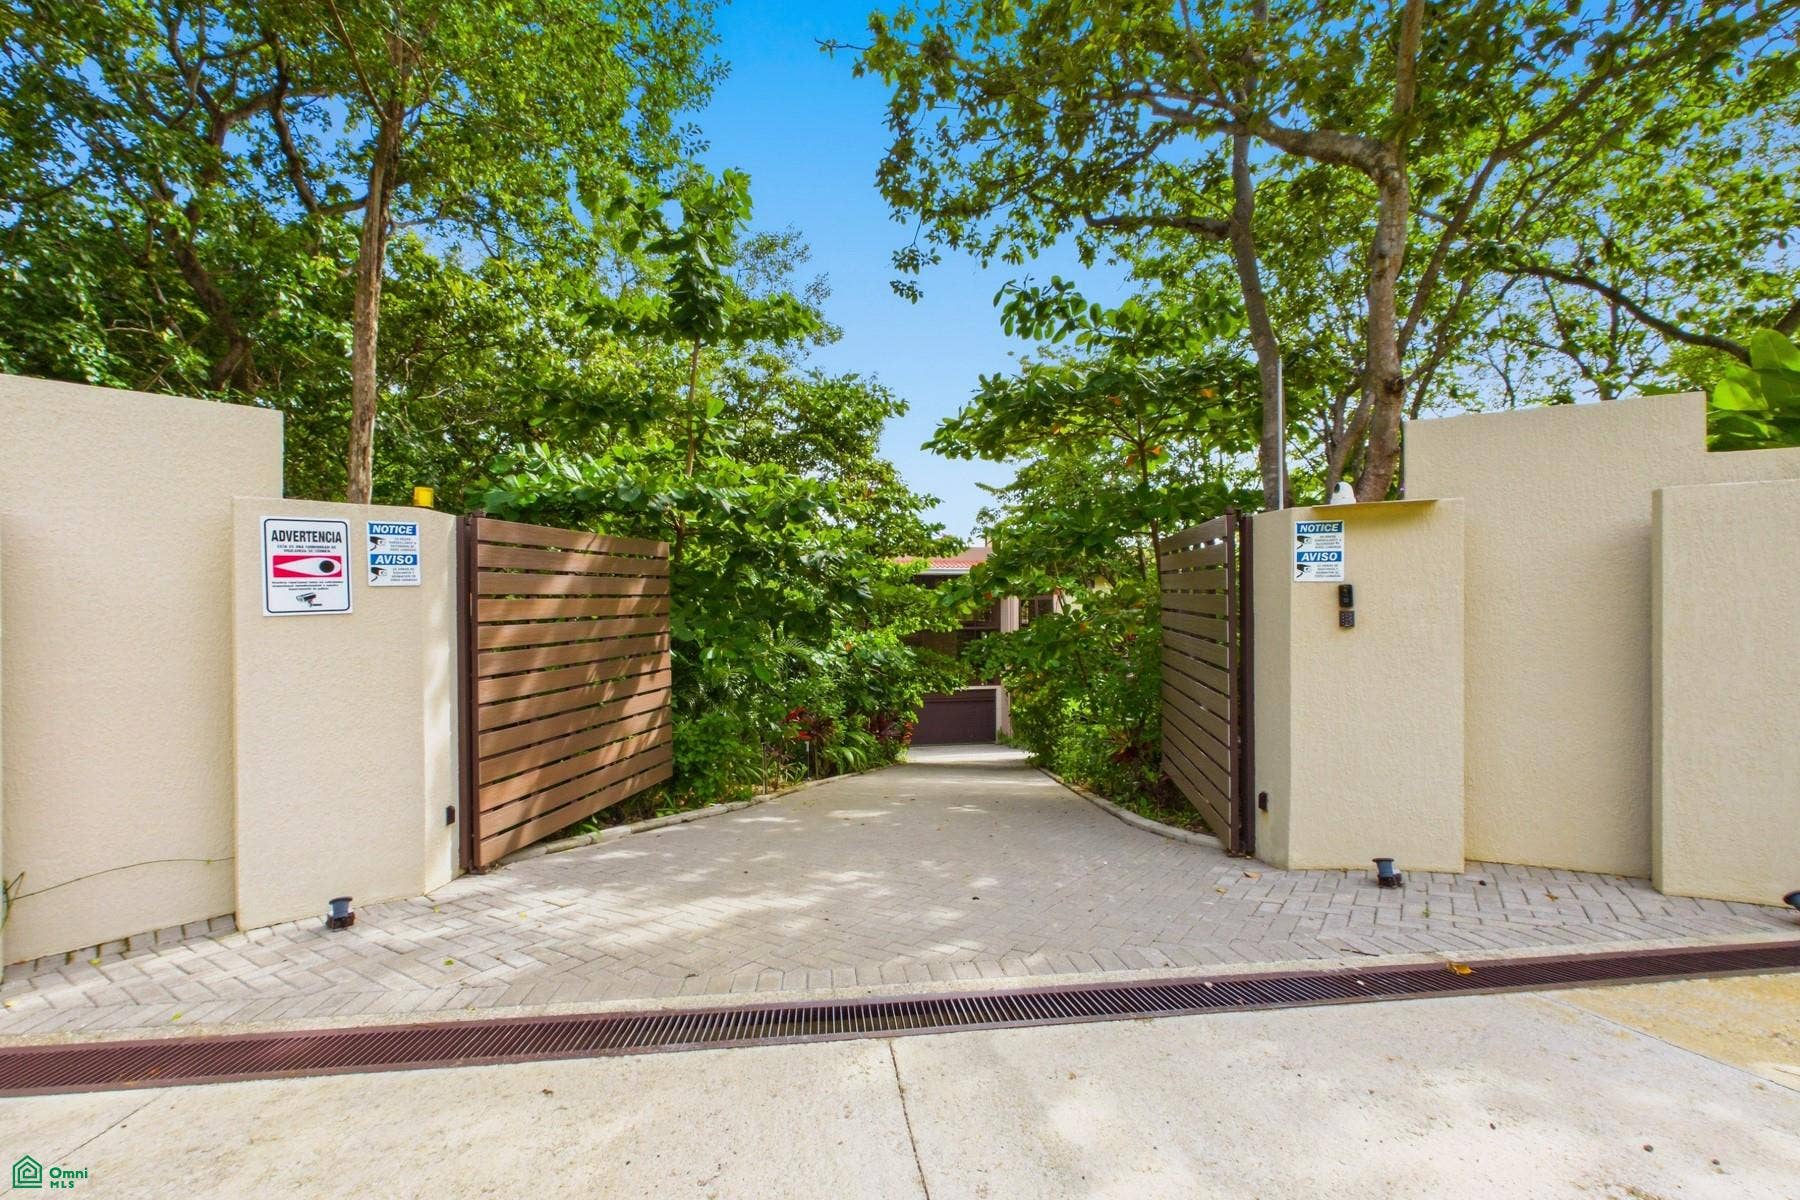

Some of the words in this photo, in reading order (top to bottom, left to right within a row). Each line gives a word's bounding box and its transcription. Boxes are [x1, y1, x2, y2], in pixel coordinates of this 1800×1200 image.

[372, 524, 414, 534] NOTICE
[1299, 523, 1339, 533] NOTICE
[271, 530, 343, 543] ADVERTENCIA
[375, 554, 414, 564] AVISO
[1300, 552, 1338, 562] AVISO
